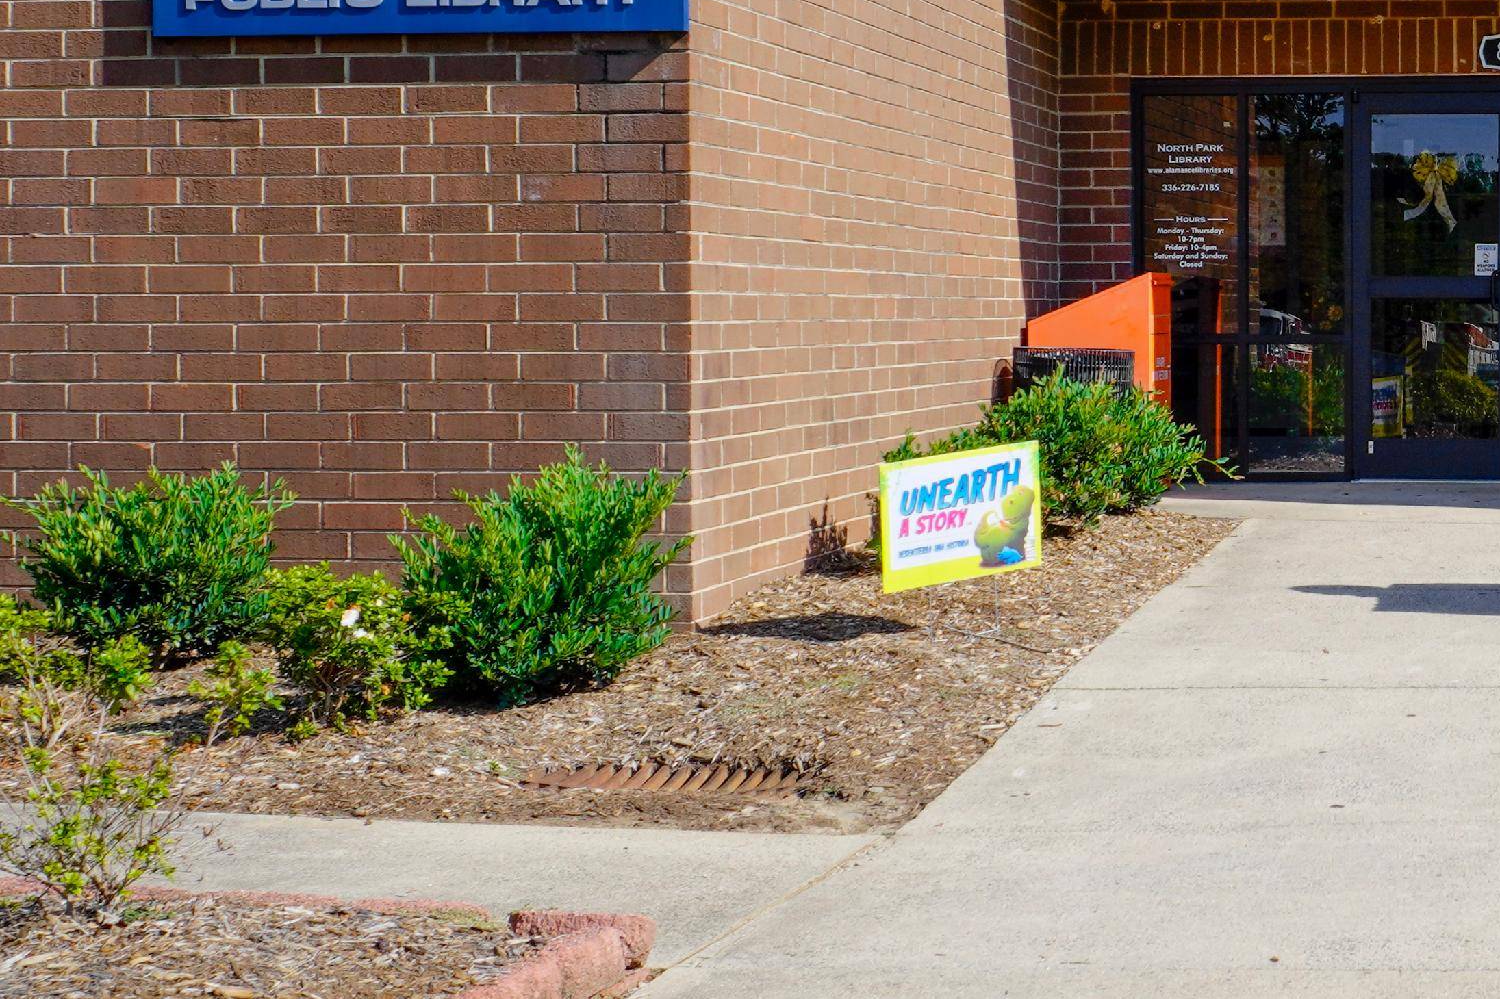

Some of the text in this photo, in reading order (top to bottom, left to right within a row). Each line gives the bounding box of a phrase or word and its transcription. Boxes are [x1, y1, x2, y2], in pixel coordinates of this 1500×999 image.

[1157, 143, 1224, 152] NORTH PARK
[1168, 155, 1212, 164] LIBRARY
[1157, 227, 1184, 235] Monday
[1191, 227, 1224, 235] Thursday:
[1153, 252, 1184, 260] Saturday
[1200, 252, 1228, 260] Sunday:
[900, 458, 1021, 516] UNEARTH
[898, 508, 968, 538] A STORY
